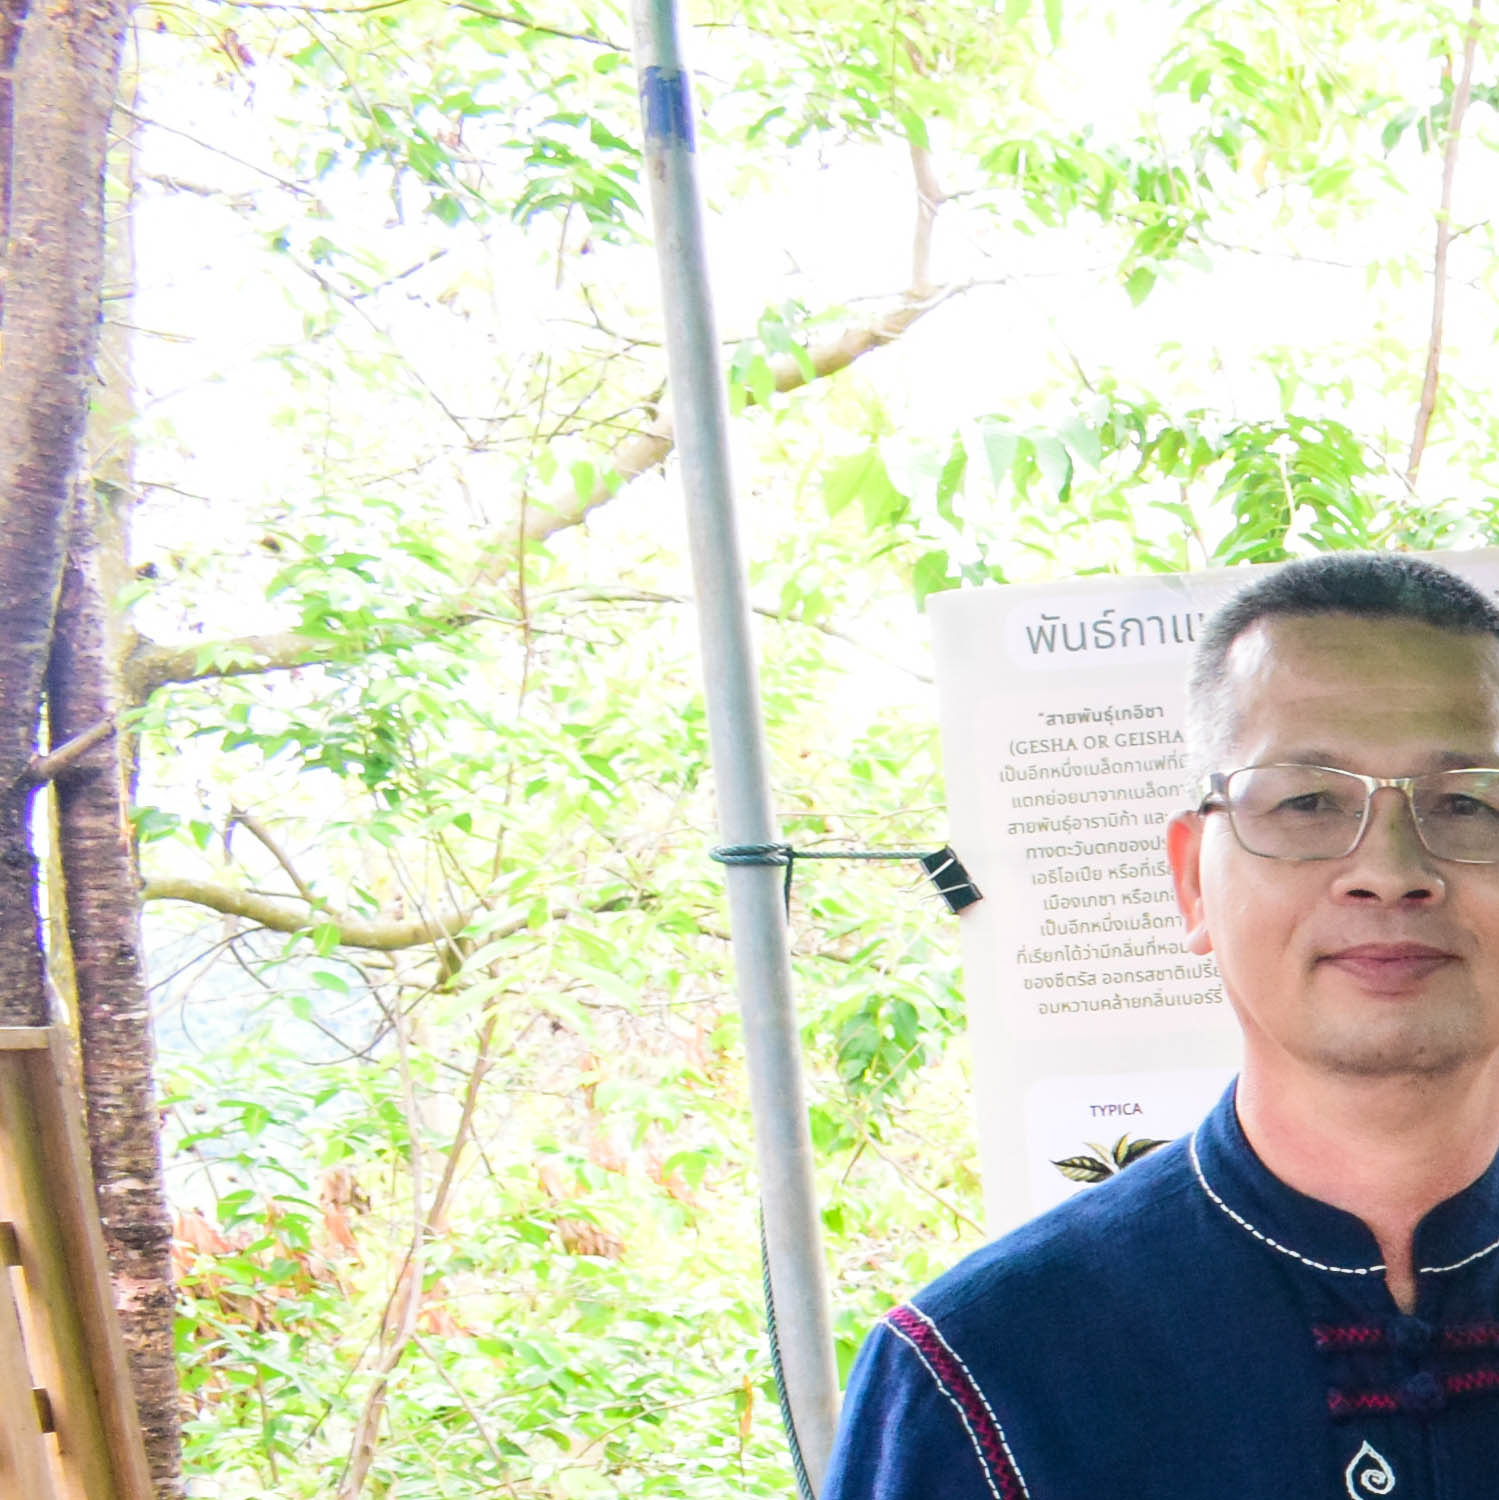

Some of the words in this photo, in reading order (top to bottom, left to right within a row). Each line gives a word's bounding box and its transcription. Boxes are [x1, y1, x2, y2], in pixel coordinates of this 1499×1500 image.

[1025, 608, 1204, 655] พันธ์กาแ
[1083, 734, 1110, 750] OR
[1114, 729, 1185, 748] GEISHA
[1025, 836, 1167, 860] ทางตะวันตกของป
[1089, 1100, 1143, 1118] TYPICA
